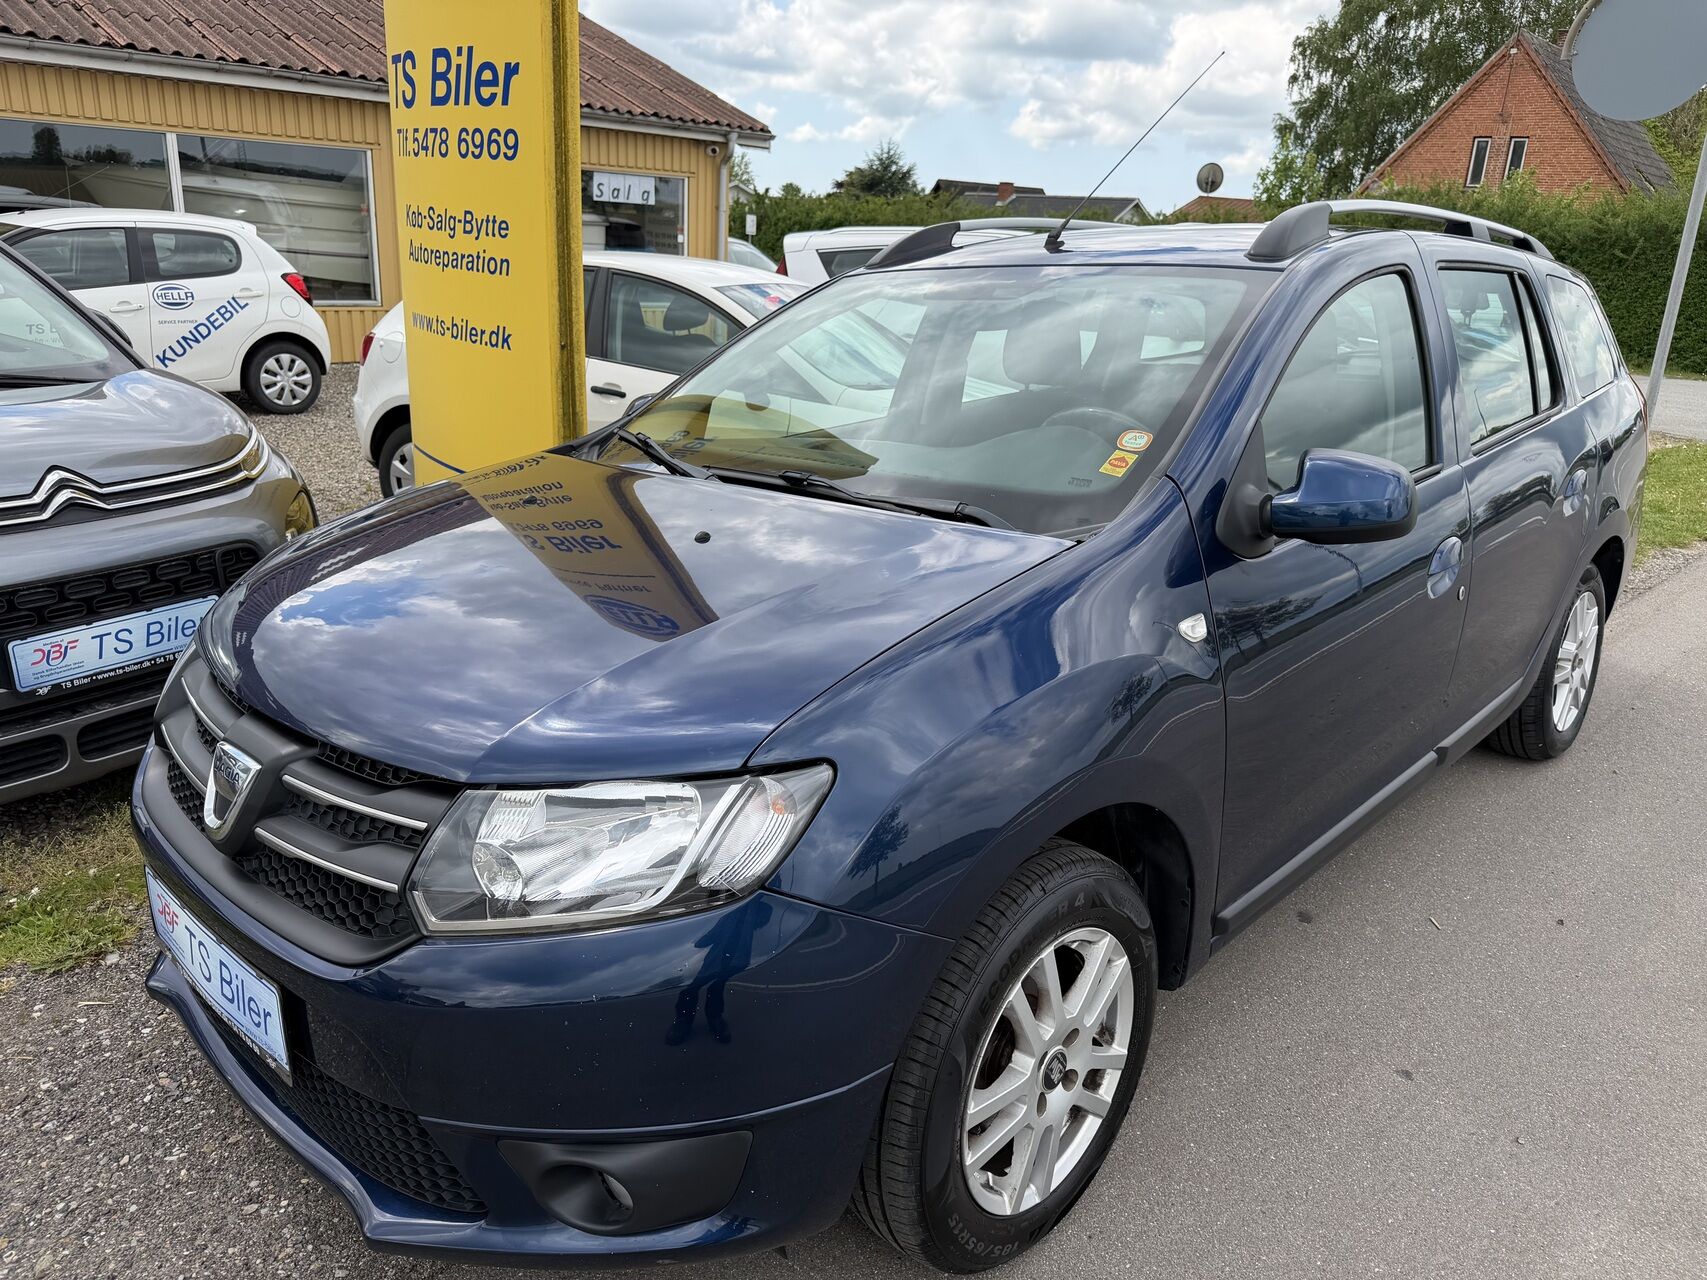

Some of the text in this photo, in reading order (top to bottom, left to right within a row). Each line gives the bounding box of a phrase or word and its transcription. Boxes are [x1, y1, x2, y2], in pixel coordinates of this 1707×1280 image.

[391, 45, 520, 109] TS Biler
[457, 127, 519, 161] 6969
[595, 182, 651, 204] Salg
[405, 203, 510, 240] Køb-Salg-Bytte
[408, 238, 511, 276] Autoreparation
[156, 291, 195, 301] HELLA
[155, 296, 249, 368] KUNDEBIL
[411, 311, 512, 350] www.ts-biler.dk
[90, 615, 203, 659] TS Bile
[61, 681, 73, 689] TS
[73, 676, 92, 687] Biler
[97, 659, 152, 680] www.ts-biler.dk
[185, 924, 212, 983] TS
[219, 958, 272, 1036] Biler
